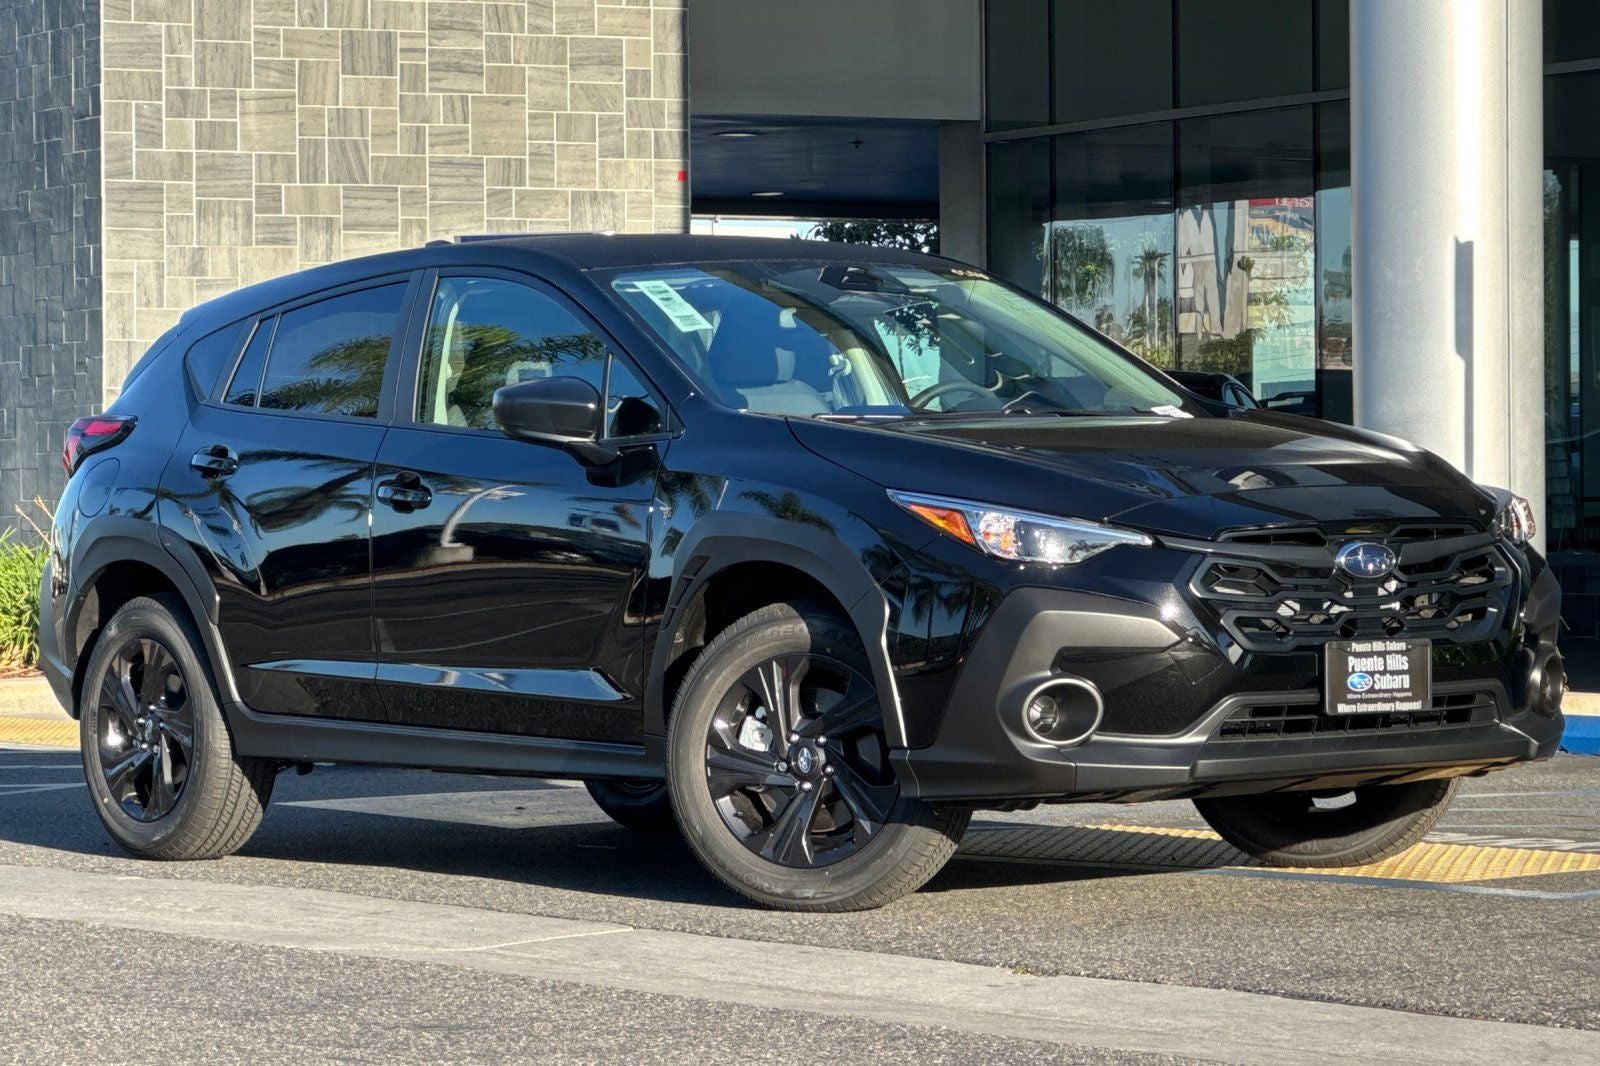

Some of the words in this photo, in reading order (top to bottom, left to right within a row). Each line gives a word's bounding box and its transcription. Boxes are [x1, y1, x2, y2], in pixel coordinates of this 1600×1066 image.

[1352, 642, 1372, 652] Puente
[1372, 642, 1386, 652] Hills
[1386, 641, 1406, 651] Subaru
[1348, 655, 1384, 672] Puente
[1386, 654, 1408, 670] Hills
[1374, 674, 1410, 690] Subaru
[1337, 702, 1356, 714] Where
[1357, 701, 1394, 712] Extraordinary
[1396, 700, 1422, 712] Happens!
